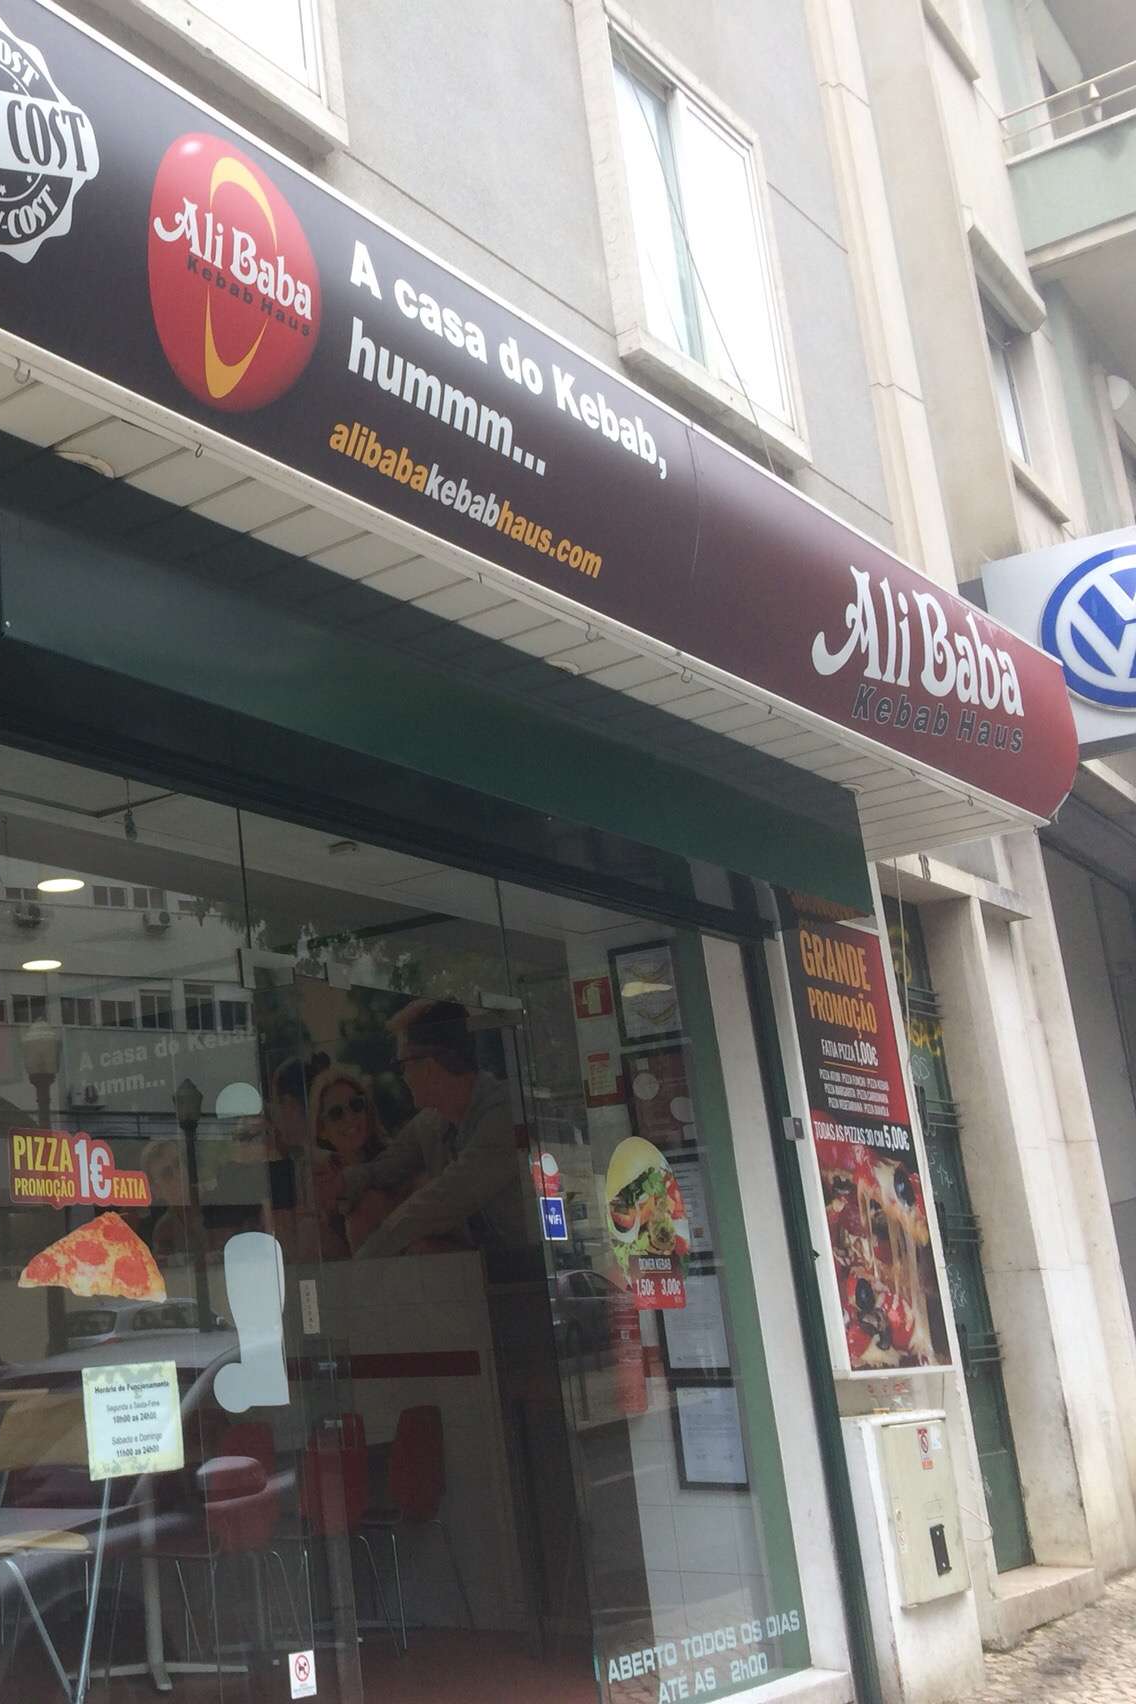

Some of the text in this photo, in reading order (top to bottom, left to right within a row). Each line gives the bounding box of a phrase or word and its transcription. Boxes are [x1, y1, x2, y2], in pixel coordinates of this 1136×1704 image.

[153, 197, 312, 320] Ali Baba
[187, 255, 311, 336] Kebab Haus
[349, 239, 668, 479] A casa do Kebab,
[348, 316, 546, 476] hummm...
[329, 422, 603, 579] alibabakebabhaus.com
[812, 565, 1025, 717] Ali Baba
[852, 683, 1024, 753] Kebab Haus
[800, 929, 871, 991] GRANDE
[807, 986, 878, 1039] PROMOÇÃO
[100, 1045, 148, 1068] casa
[13, 1135, 112, 1199] PIZZA 1€
[883, 1125, 910, 1151] 5,00€
[14, 1176, 147, 1202] PROMOÇÃO FATIA
[608, 1609, 800, 1684] ABERTO TODOS OS DIAS
[694, 1667, 717, 1696] AS
[730, 1652, 769, 1683] 2h00
